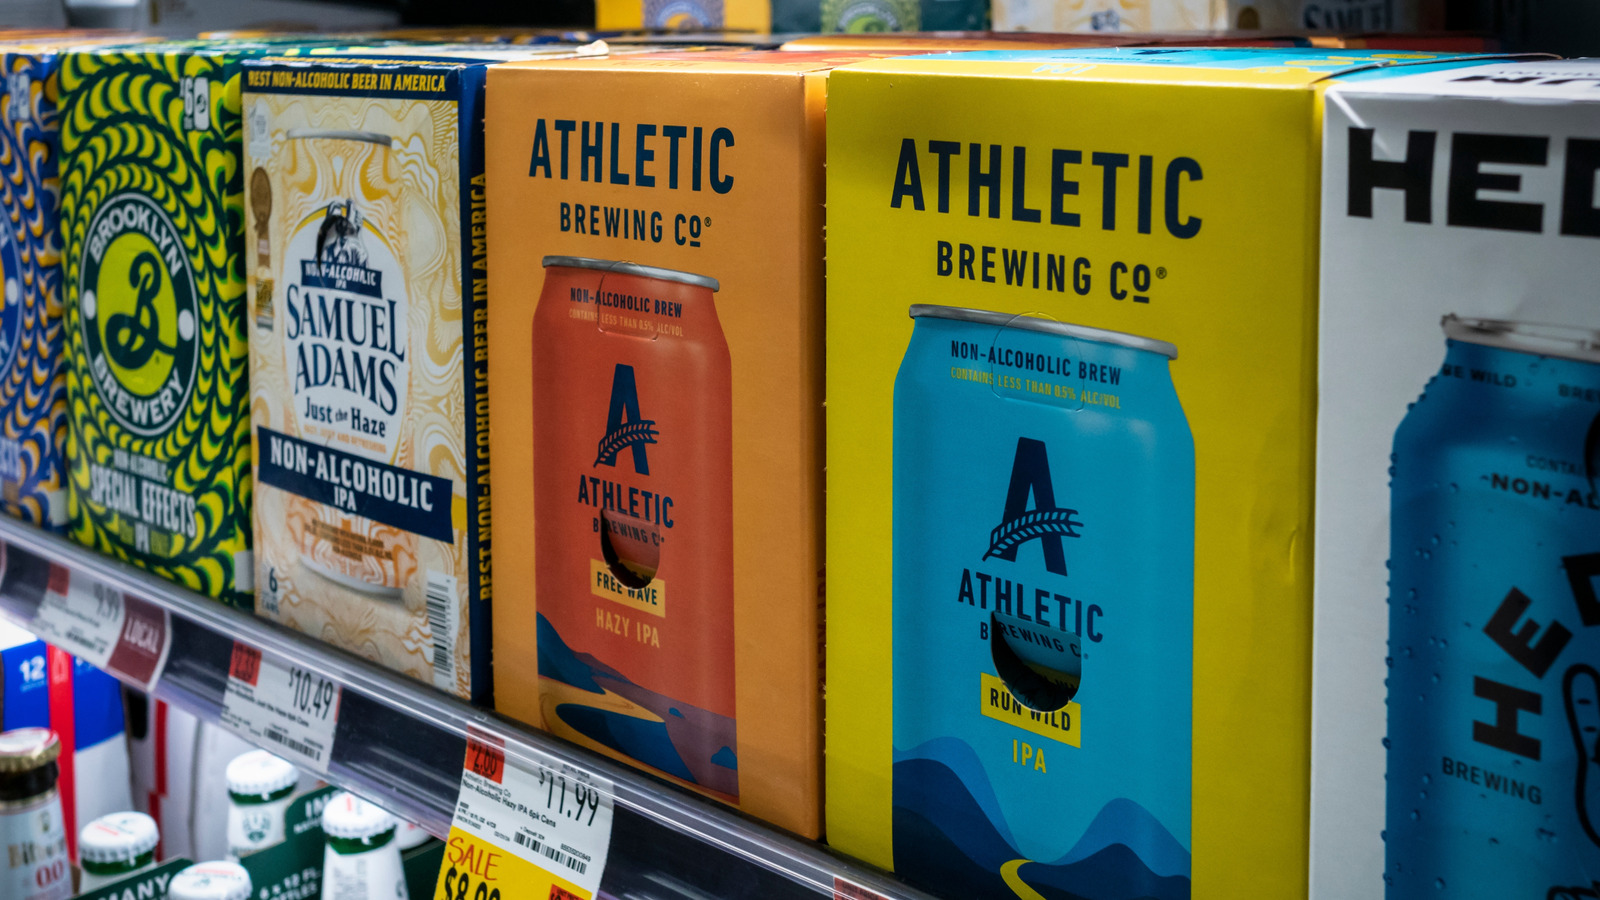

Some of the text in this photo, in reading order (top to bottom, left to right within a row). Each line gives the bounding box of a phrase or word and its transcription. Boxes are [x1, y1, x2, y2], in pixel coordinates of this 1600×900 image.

[248, 70, 447, 93] BEST NON-ALCOHOLIC BEER IN AMERICA
[529, 118, 735, 195] ATHLETIC
[890, 138, 1204, 240] ATHLETIC
[90, 203, 183, 278] BROOKLYN
[471, 173, 488, 270] AMERICA
[560, 202, 663, 243] BREWING
[473, 279, 488, 302] IN
[937, 240, 1092, 296] BREWING
[287, 284, 405, 362] SAMUEL
[570, 287, 682, 318] NON-ALCOHOLIC BREW
[474, 308, 489, 362] BEER
[601, 314, 618, 326] LESS
[620, 316, 637, 329] THAN
[656, 323, 684, 337] ALC/VOL
[295, 341, 398, 416] ADAMS
[951, 340, 1122, 386] NON-ALCOHOLIC BREW
[951, 367, 994, 386] CONTAINS
[998, 374, 1022, 390] LESS
[1025, 379, 1052, 396] THAN
[1054, 385, 1077, 401] 0.5%
[1470, 367, 1518, 389] WILD
[95, 352, 184, 425] BREWERY
[304, 397, 333, 424] Just
[351, 406, 387, 438] Haze
[270, 436, 434, 513] NON-ALCOHOLIC
[91, 463, 140, 519] SPECIAL
[141, 479, 196, 539] EFFECTS
[334, 485, 358, 512] IPA
[578, 474, 674, 529] ATHLETIC
[268, 566, 278, 593] 6
[479, 548, 493, 600] BEST
[596, 571, 623, 595] FREE
[596, 607, 661, 649] HAZY IPA
[958, 568, 1104, 644] ATHLETIC
[124, 617, 159, 653] LOCAL
[20, 656, 46, 683] 12
[287, 666, 334, 720] $10.49
[990, 687, 1071, 732] RUN WILD
[1012, 739, 1047, 774] IPA
[1442, 756, 1543, 806] BREWING
[517, 803, 528, 815] IPA
[540, 813, 557, 829] Cans
[448, 836, 503, 881] SALE
